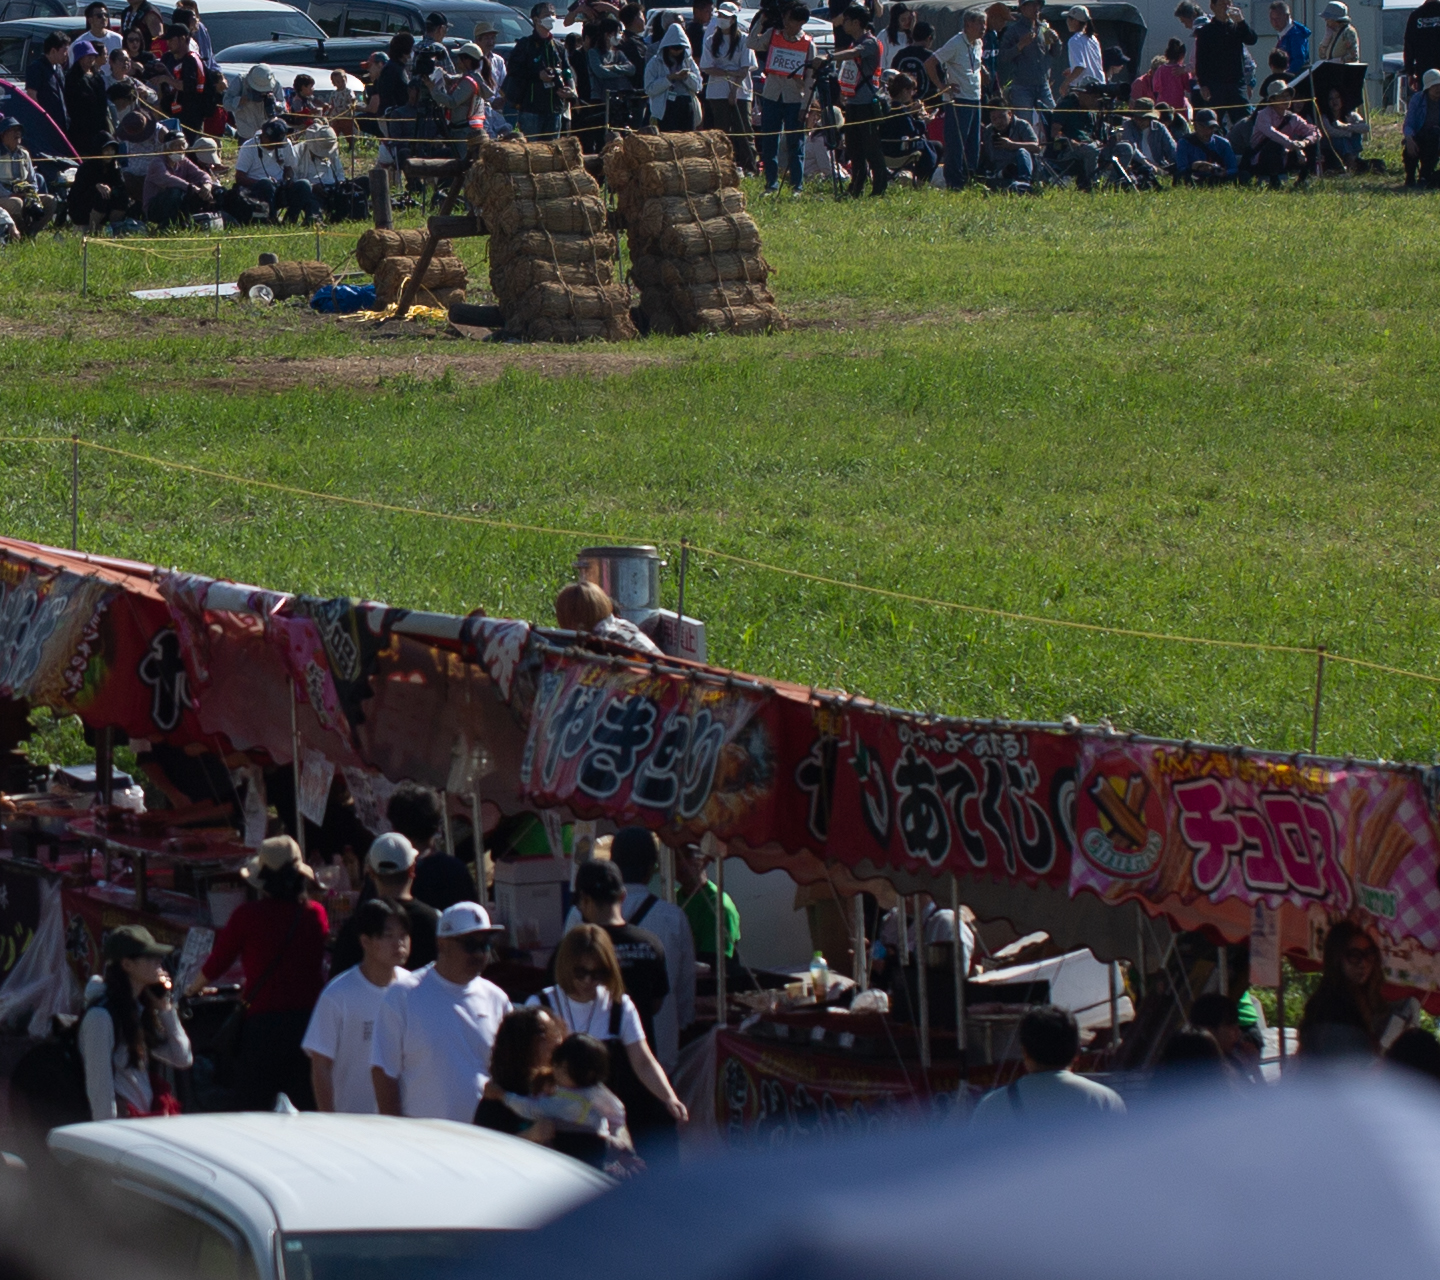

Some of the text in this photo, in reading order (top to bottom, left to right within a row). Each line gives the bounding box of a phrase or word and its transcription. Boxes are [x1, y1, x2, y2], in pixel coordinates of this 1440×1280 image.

[772, 56, 802, 73] PRESS
[541, 683, 726, 820] やきとり
[891, 743, 1057, 875] あてくじ
[1172, 776, 1354, 911] チュロス
